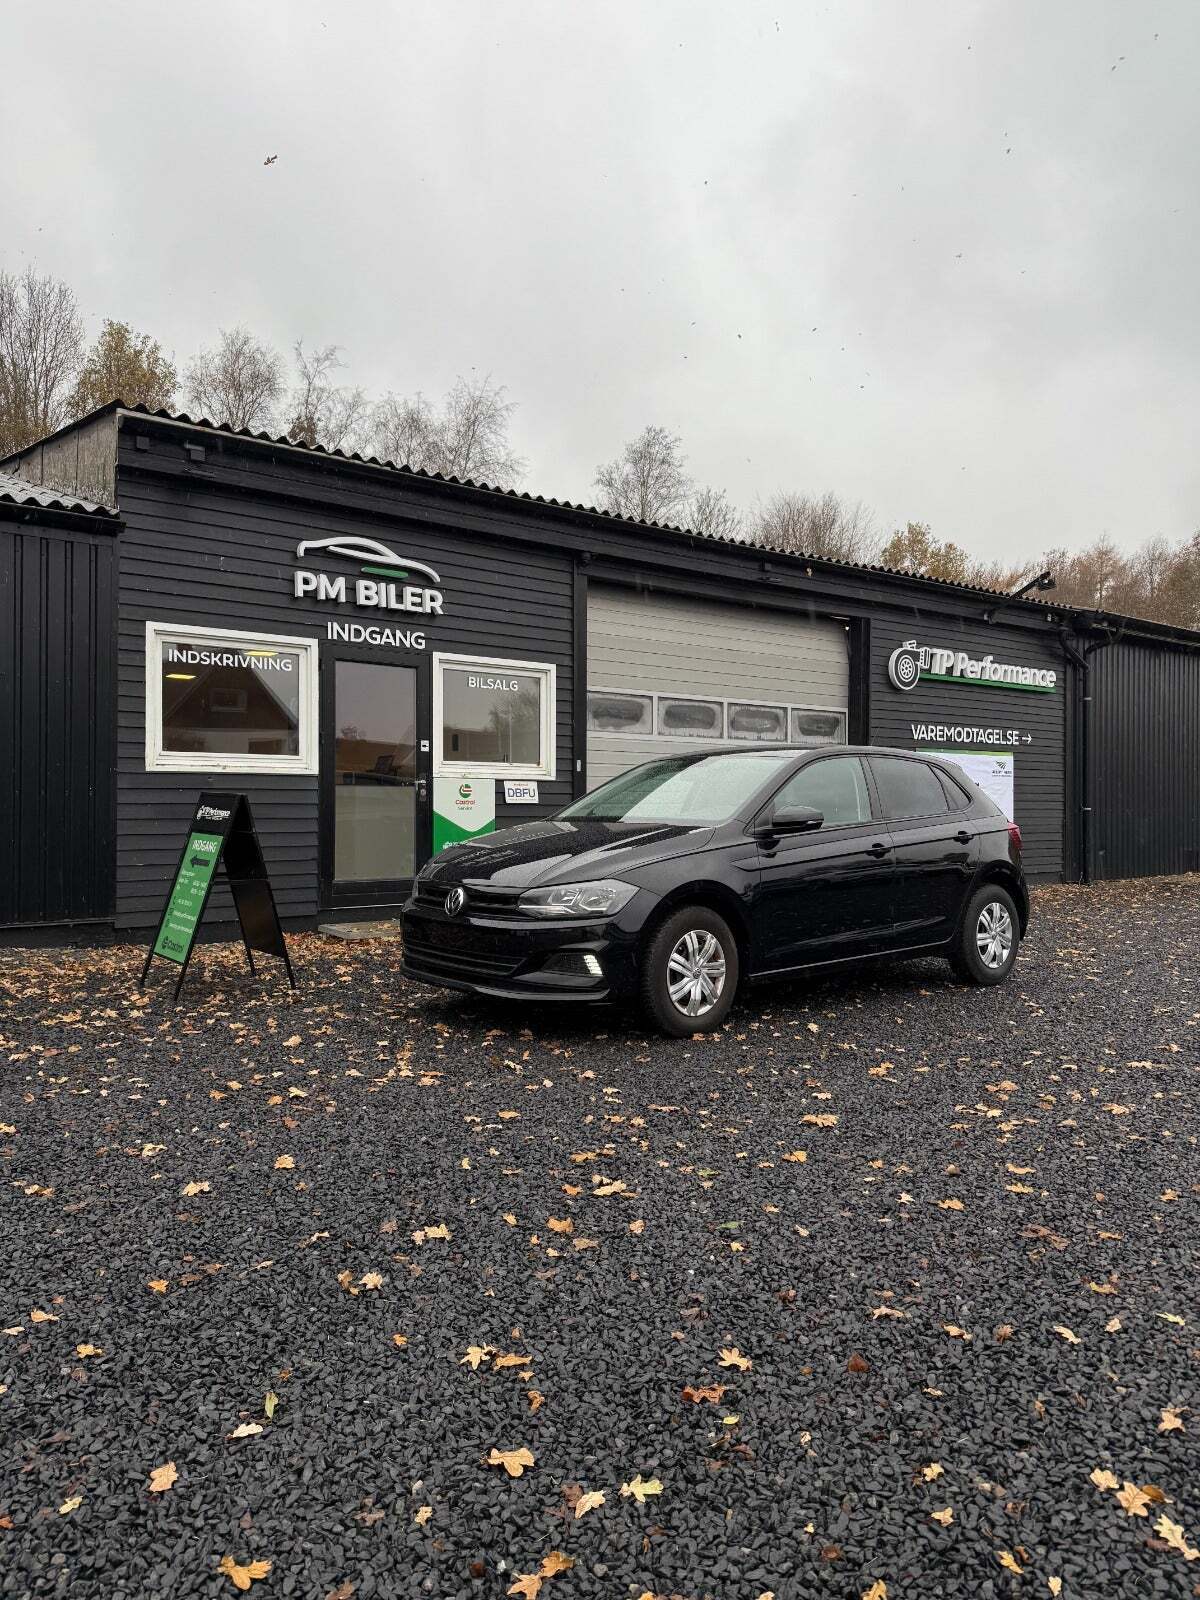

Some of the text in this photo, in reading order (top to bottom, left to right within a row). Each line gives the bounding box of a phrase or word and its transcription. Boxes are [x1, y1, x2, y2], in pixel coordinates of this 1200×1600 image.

[294, 571, 444, 615] PM BILER
[327, 621, 426, 649] INDGANG
[168, 648, 292, 671] INDSKRIVNING
[953, 653, 1057, 687] Performance
[468, 676, 519, 691] BILSALG
[911, 724, 1020, 745] VAREMODTAGELSE
[507, 787, 536, 798] DBFU
